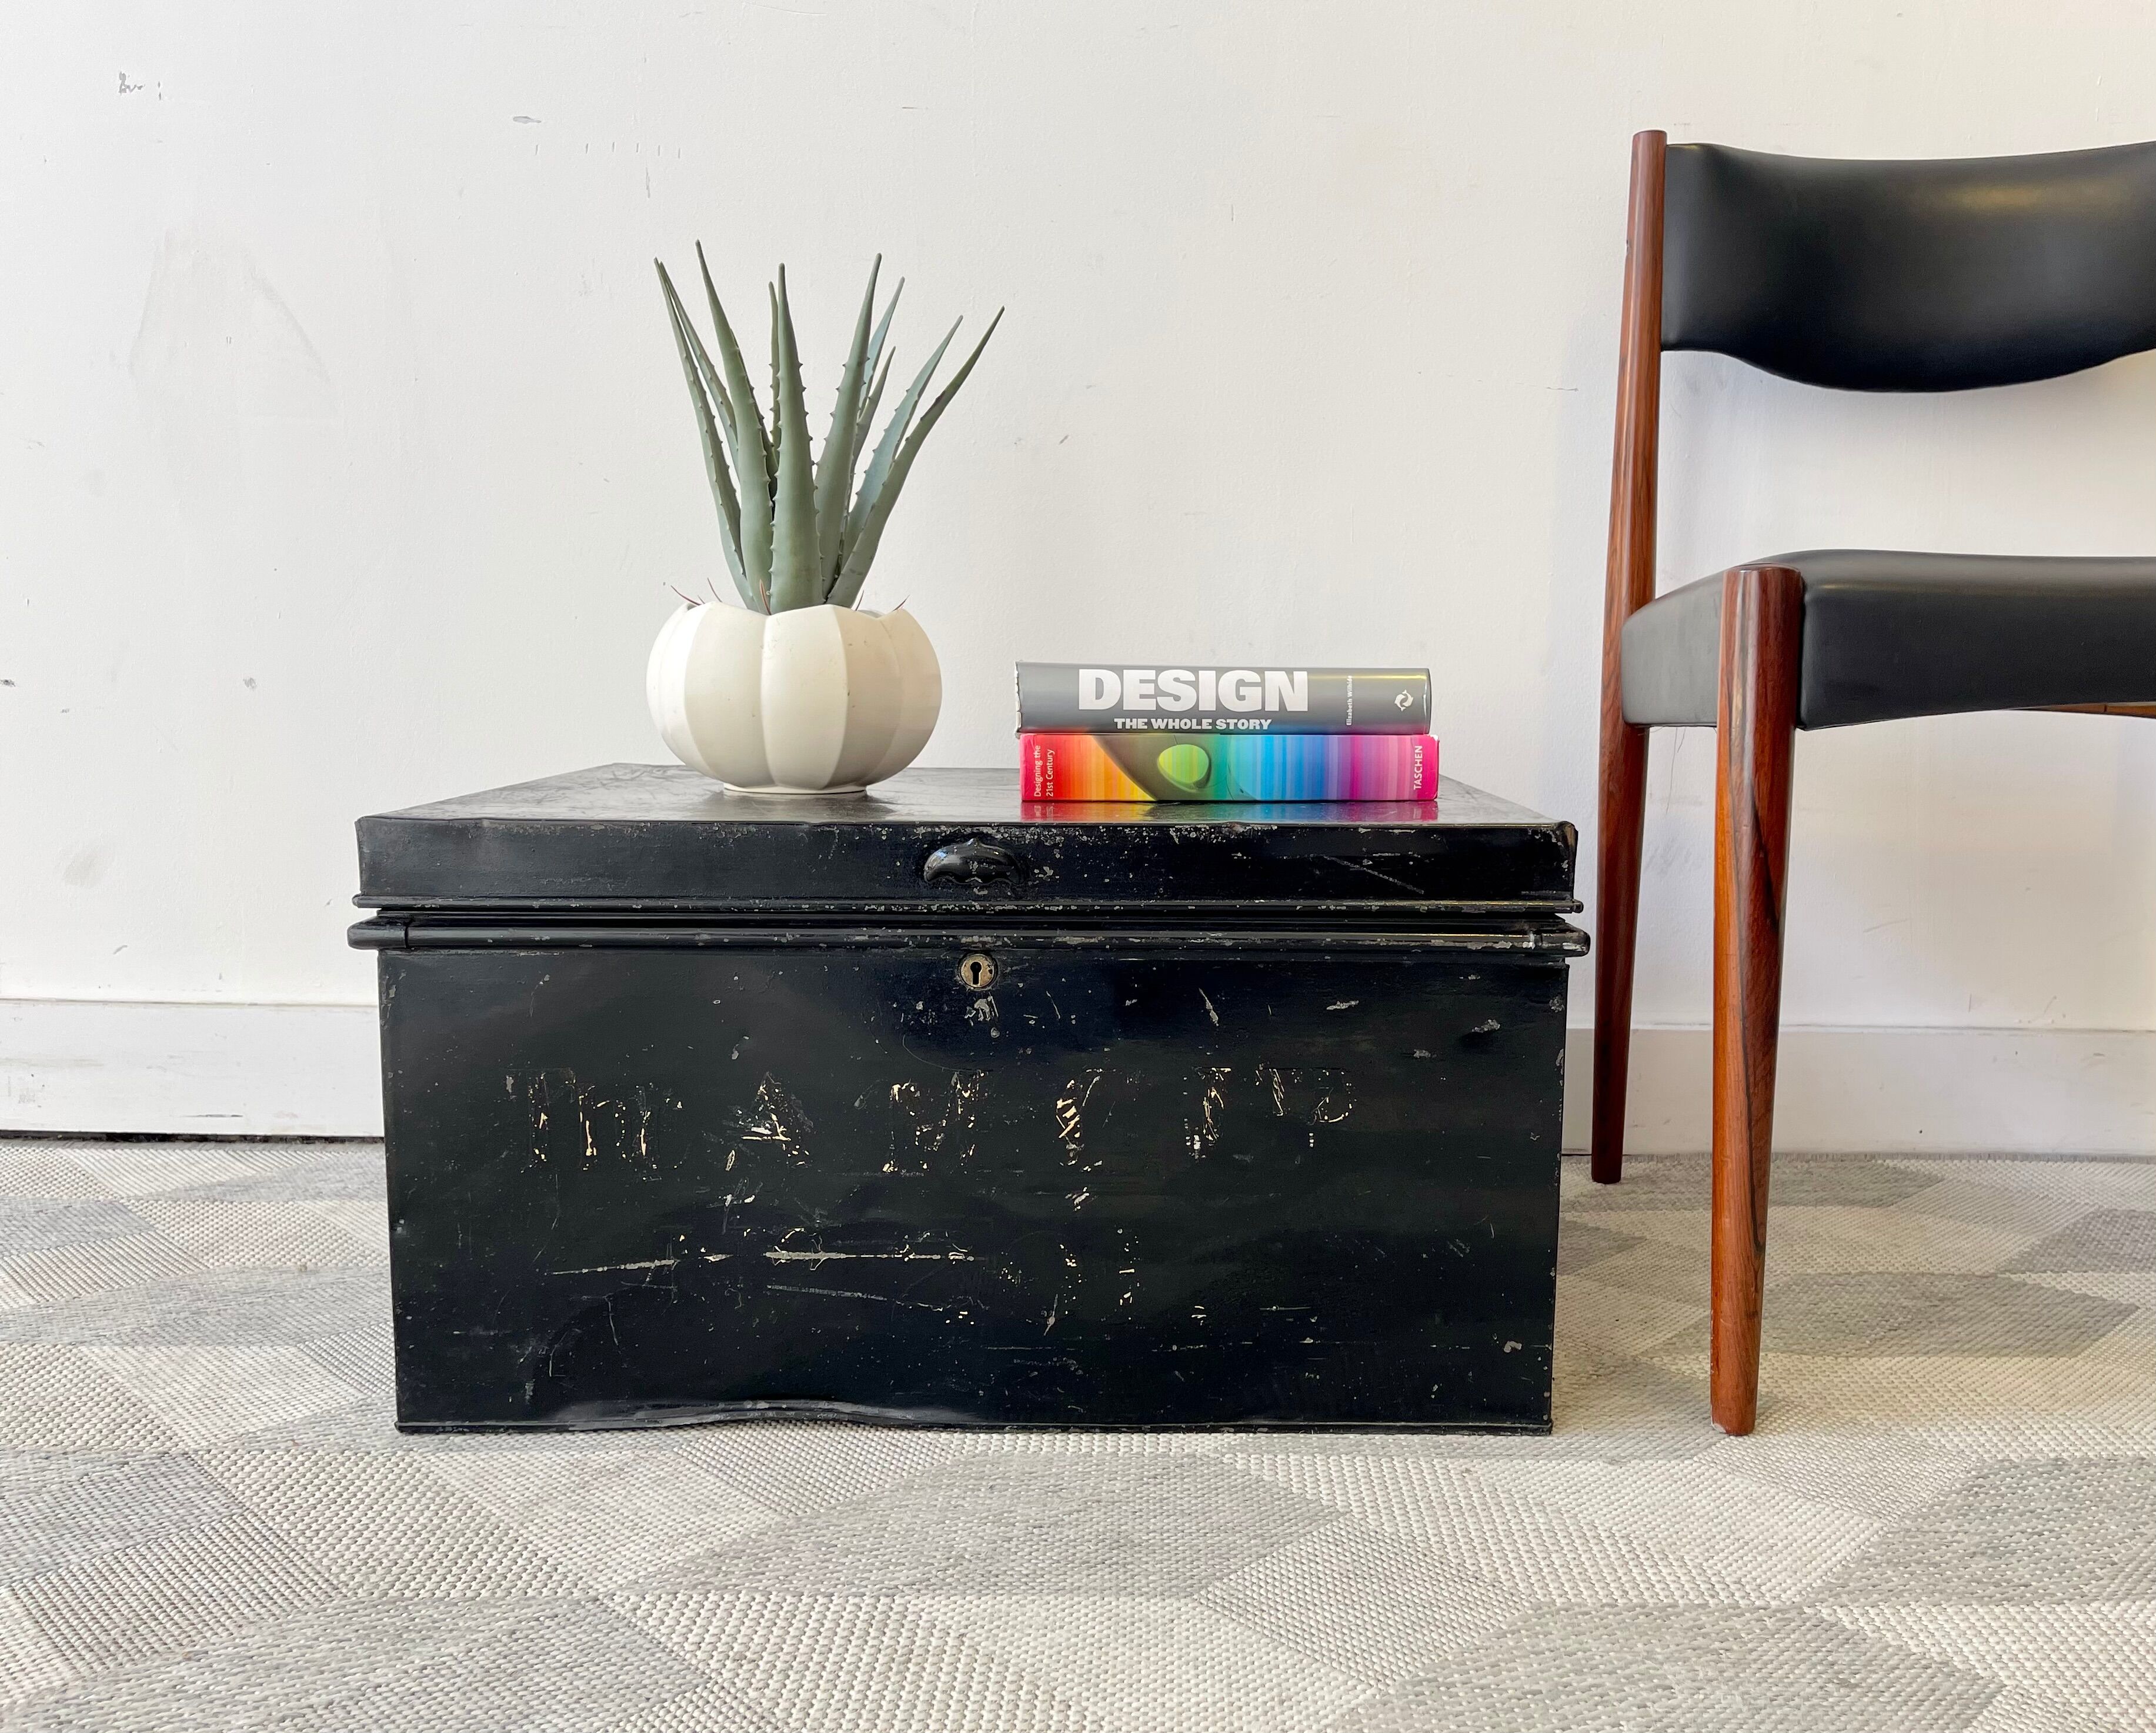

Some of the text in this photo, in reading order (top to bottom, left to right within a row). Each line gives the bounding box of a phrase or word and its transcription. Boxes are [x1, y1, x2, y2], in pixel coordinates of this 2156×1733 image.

[1079, 669, 1308, 712] DESIGN
[1114, 718, 1272, 730] THE WHOLE STORY
[1034, 760, 1043, 797] Designing
[1046, 749, 1056, 780] Century
[1413, 745, 1423, 790] TASCHEN
